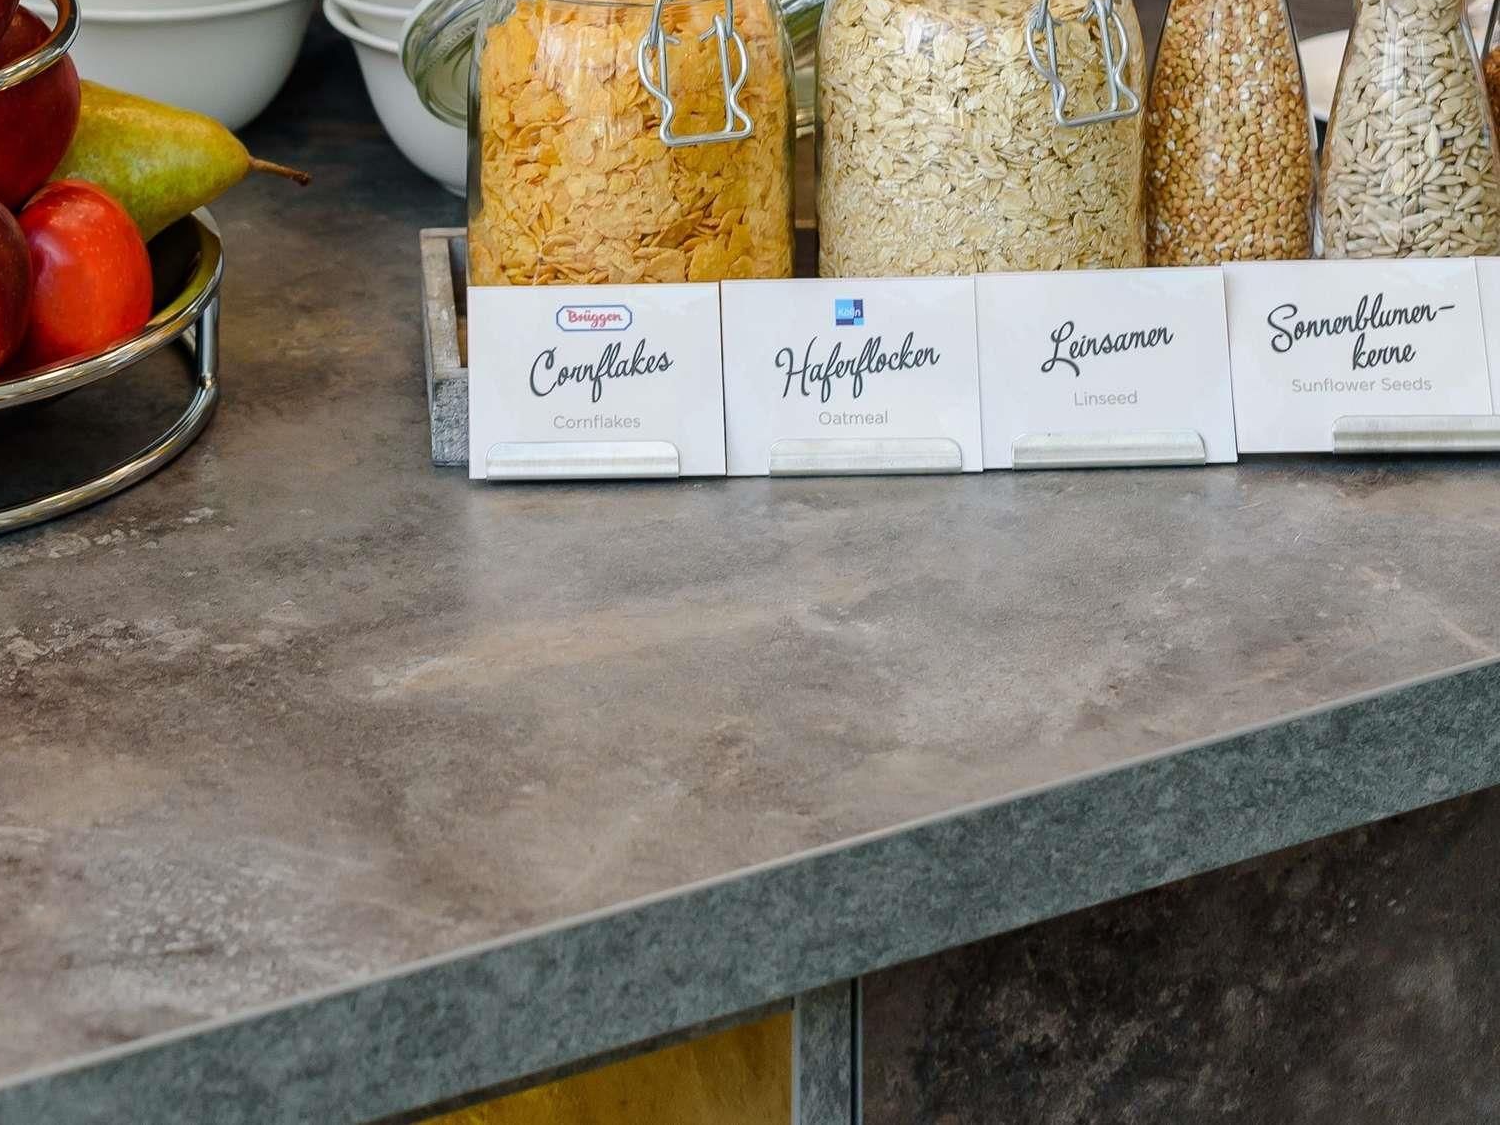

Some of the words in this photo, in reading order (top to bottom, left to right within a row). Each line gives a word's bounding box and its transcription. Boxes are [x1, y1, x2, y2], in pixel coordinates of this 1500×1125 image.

[566, 309, 623, 328] Brüggen
[1266, 293, 1455, 353] Sonnenblumen-
[1041, 320, 1174, 376] Leinsamen
[1352, 334, 1416, 371] kerne
[529, 337, 675, 403] Cornflakes
[775, 331, 941, 403] Haferflocken
[1074, 390, 1139, 406] Linseed
[1291, 377, 1376, 393] Sunflower
[1381, 376, 1433, 392] Seeds
[553, 413, 641, 430] Cornflakes
[818, 410, 889, 426] Oatmeal
